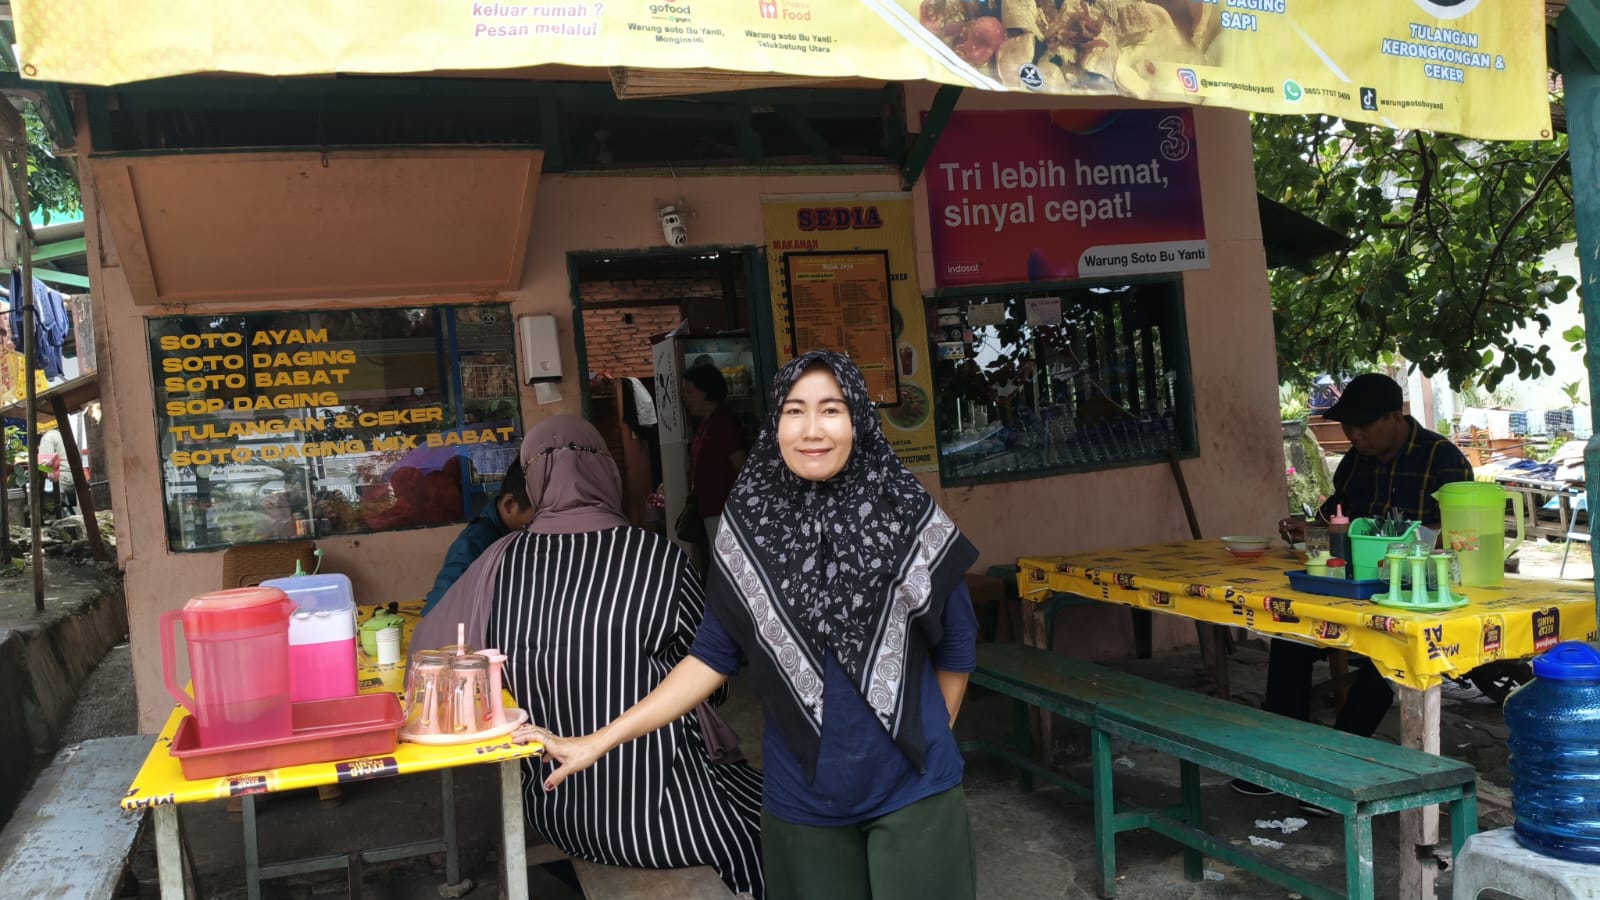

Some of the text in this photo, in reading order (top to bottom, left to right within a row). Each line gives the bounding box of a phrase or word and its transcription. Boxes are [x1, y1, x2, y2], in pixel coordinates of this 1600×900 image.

[473, 3, 604, 17] keluar rumah ?
[649, 3, 692, 15] gofood
[782, 9, 812, 22] Food
[475, 23, 598, 38] Pesan melalui
[627, 22, 725, 38] Warung soto Bu Yanti,
[1221, 11, 1257, 31] SAPI
[745, 29, 777, 41] Warung
[778, 33, 797, 41] soto
[799, 33, 811, 42] Bu
[812, 34, 833, 44] Yanti
[1409, 23, 1478, 48] TULANGAN
[809, 44, 831, 54] Utara
[1382, 38, 1505, 70] KERONGKONGAN &
[1424, 63, 1465, 84] CEKER
[1200, 78, 1275, 95] @warungsotobuyanti
[1380, 99, 1444, 111] warungsotobuyanti
[940, 158, 1169, 191] Tri lebih hemat,
[797, 206, 884, 231] SEDIA
[944, 192, 1133, 232] sinyal cepat!
[772, 240, 819, 250] MAKANAN
[1084, 248, 1206, 268] Warung Soto Bu Yanti
[947, 263, 980, 274] indosat
[160, 328, 328, 350] SOTO AYAM
[162, 349, 356, 373] SOTO DAGING
[164, 368, 350, 393] SOTO BABAT
[166, 391, 339, 416] SOP DAGING
[169, 407, 444, 443] TULANGAN & CEKER
[170, 427, 514, 467] SOTO DAGING MIX BABAT
